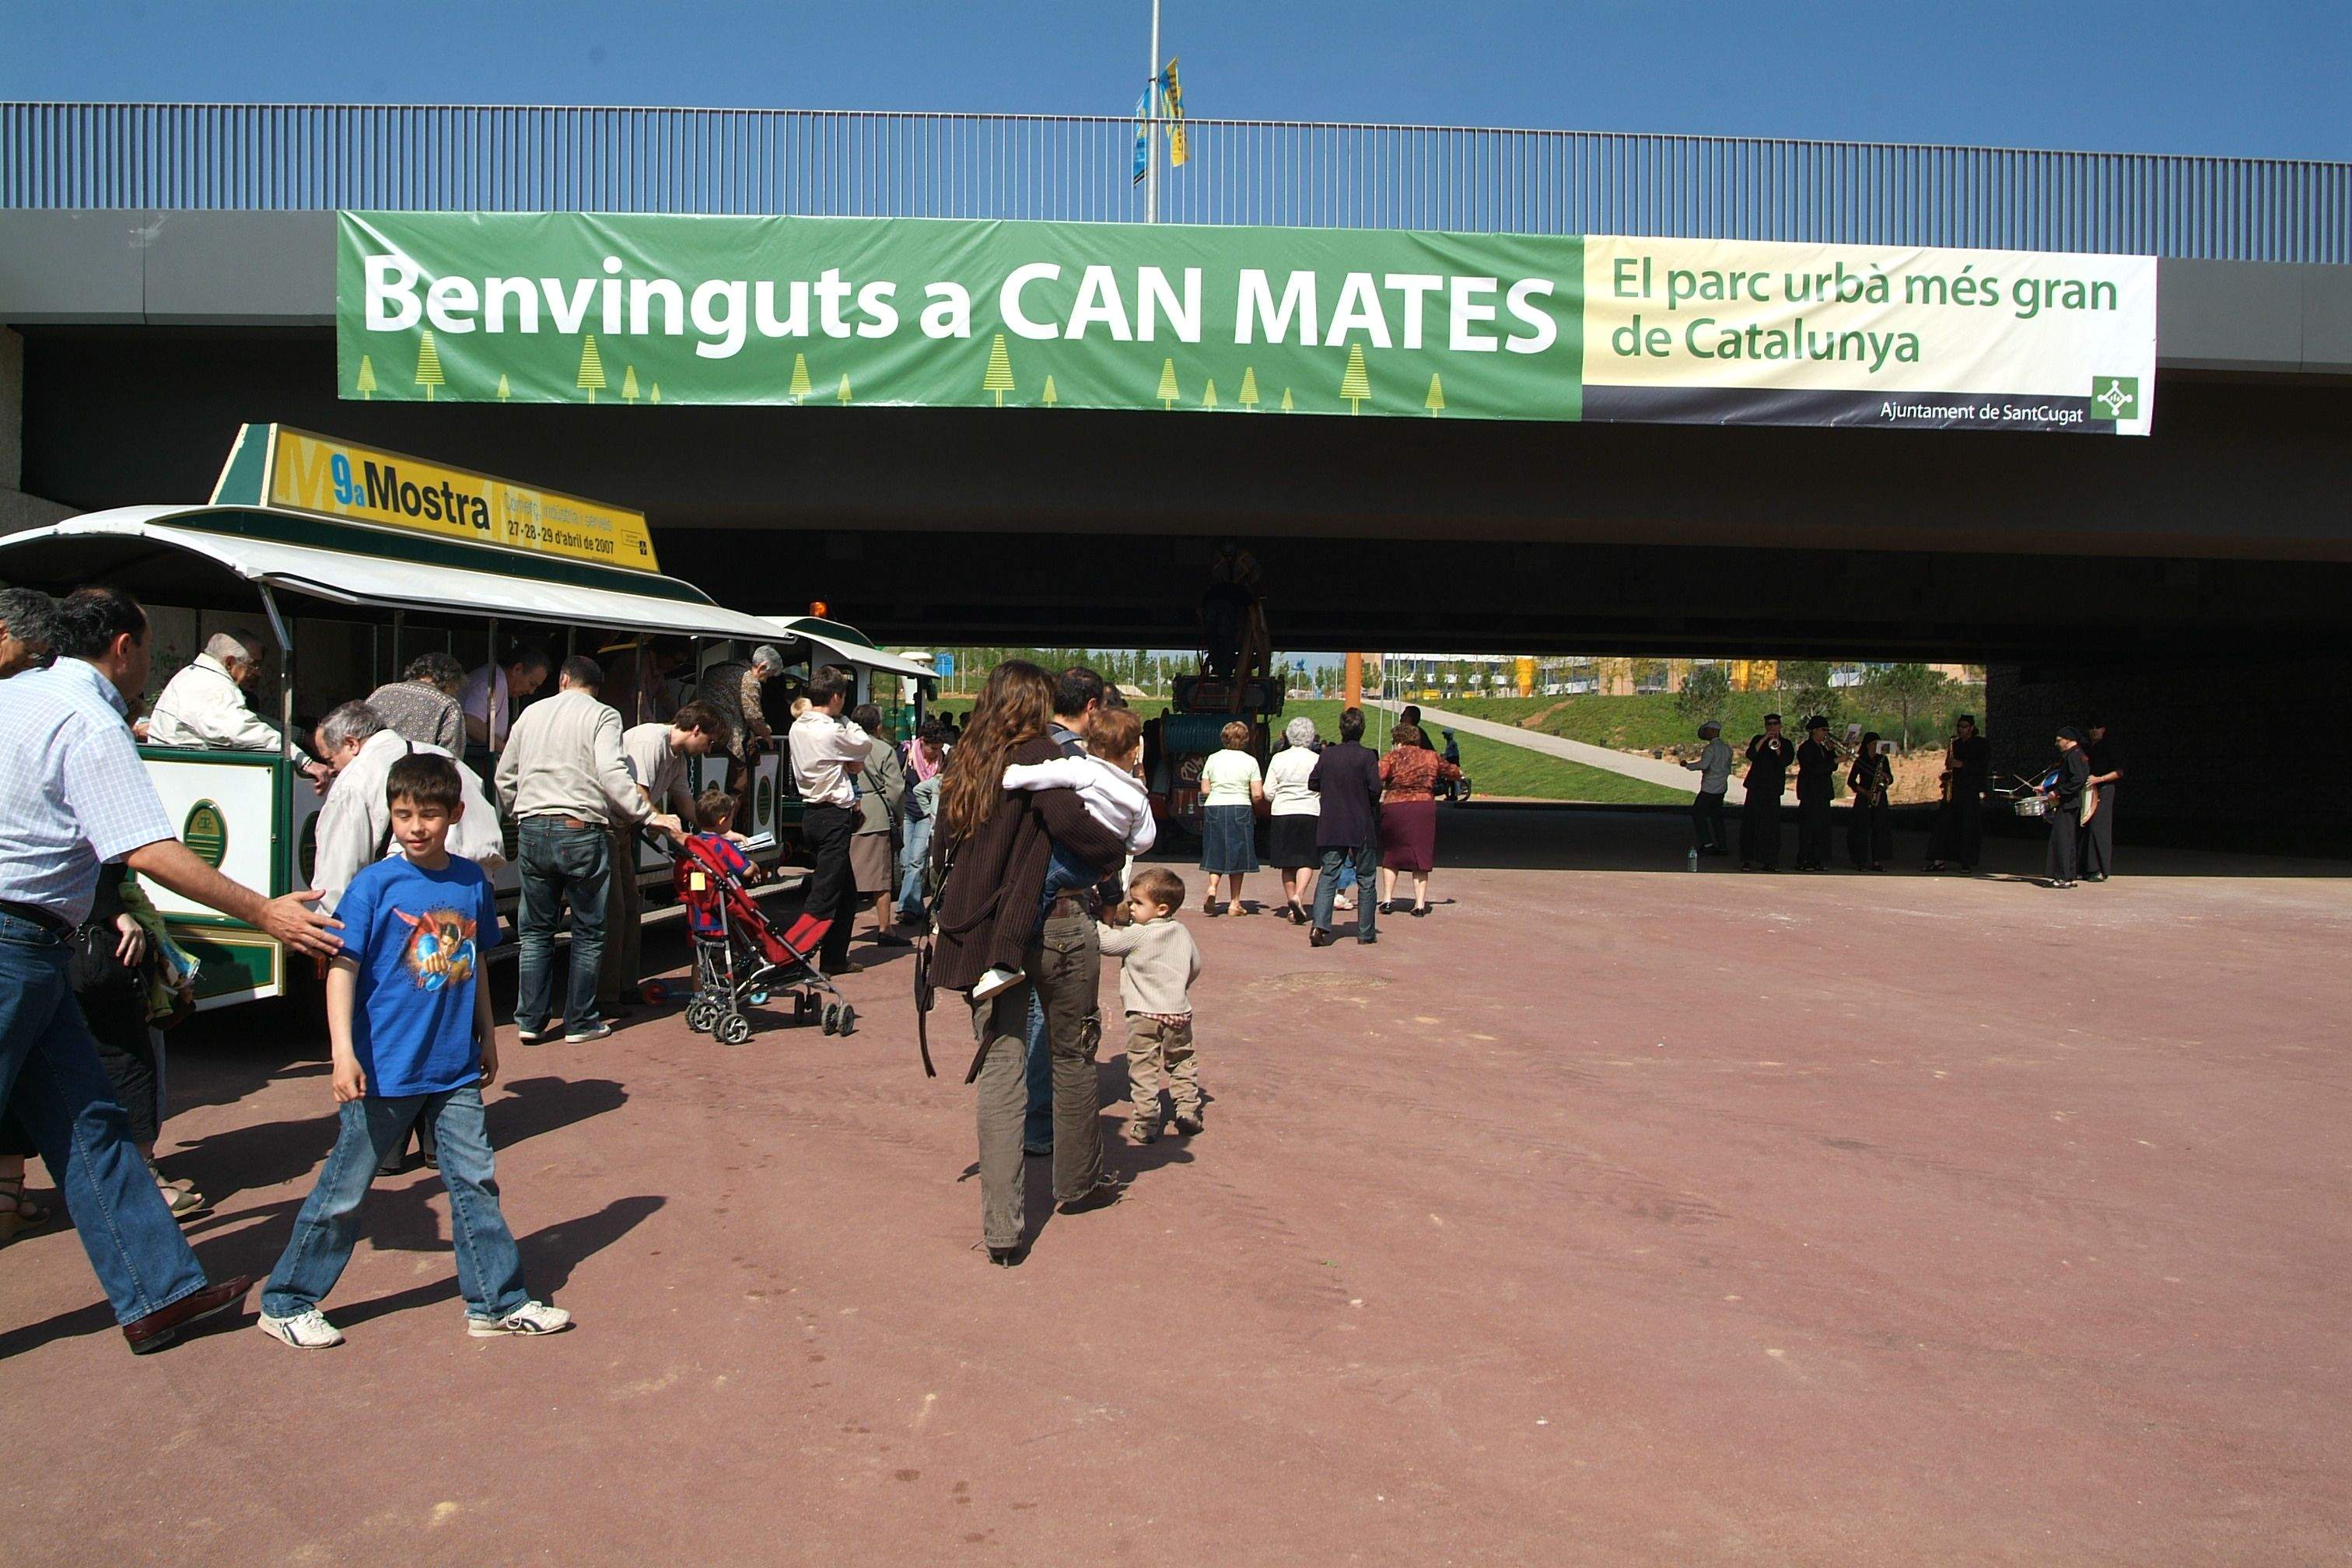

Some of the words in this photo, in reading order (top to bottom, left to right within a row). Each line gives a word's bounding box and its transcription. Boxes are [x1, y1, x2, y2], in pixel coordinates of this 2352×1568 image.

[363, 254, 899, 359] Benvinguts
[919, 282, 971, 339] a
[999, 262, 1202, 343] CAN
[1234, 268, 1557, 354] MATES
[1613, 257, 1653, 297] El
[1668, 269, 1771, 310] parc
[1785, 261, 1891, 303] urbà
[1906, 264, 2002, 307] més
[2013, 277, 2119, 320] gran
[1612, 313, 1672, 357] de
[1686, 315, 1921, 374] Catalunya
[1879, 401, 1976, 422] Ajuntament
[1979, 403, 2000, 420] de
[363, 460, 490, 530] Mostra
[555, 530, 583, 549] d'abril
[583, 537, 594, 551] de
[594, 537, 615, 555] 2007
